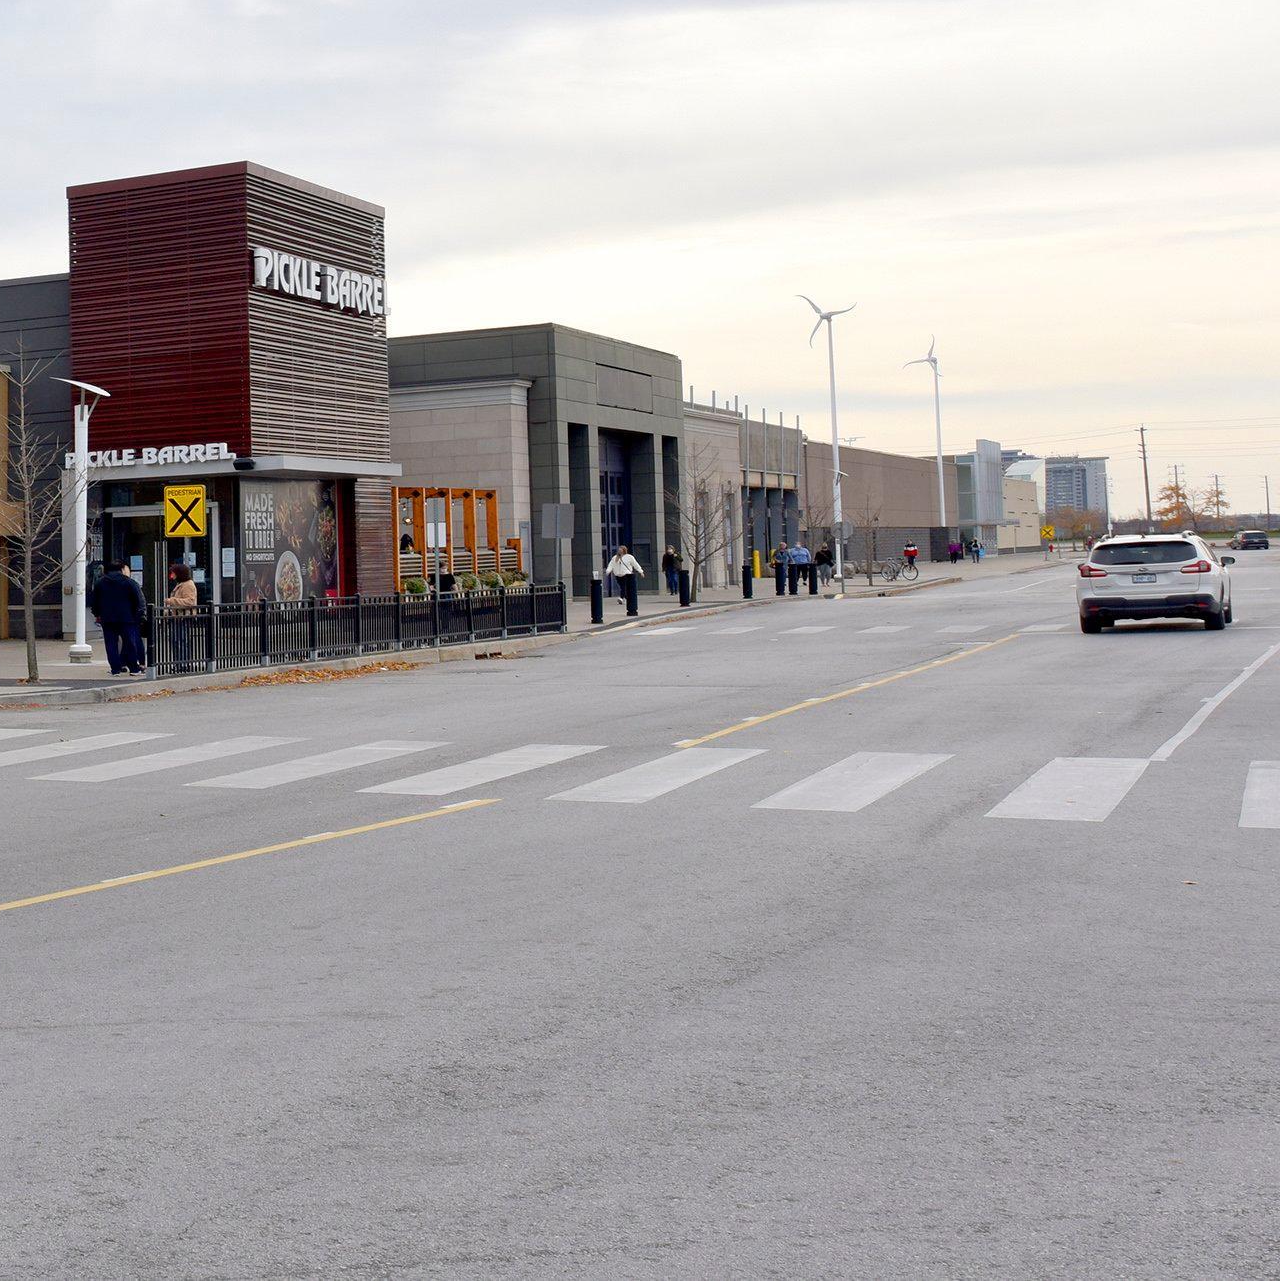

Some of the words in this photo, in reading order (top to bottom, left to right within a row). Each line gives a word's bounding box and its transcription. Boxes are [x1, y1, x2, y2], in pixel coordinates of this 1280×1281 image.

[253, 247, 322, 300] PICKLE
[322, 266, 391, 317] BARREL
[65, 449, 136, 469] PCKLE
[142, 442, 236, 465] BARREL
[168, 489, 202, 497] PEDESTRIAN
[245, 493, 274, 512] MADE
[245, 512, 275, 530] FRESH
[246, 553, 252, 561] NO
